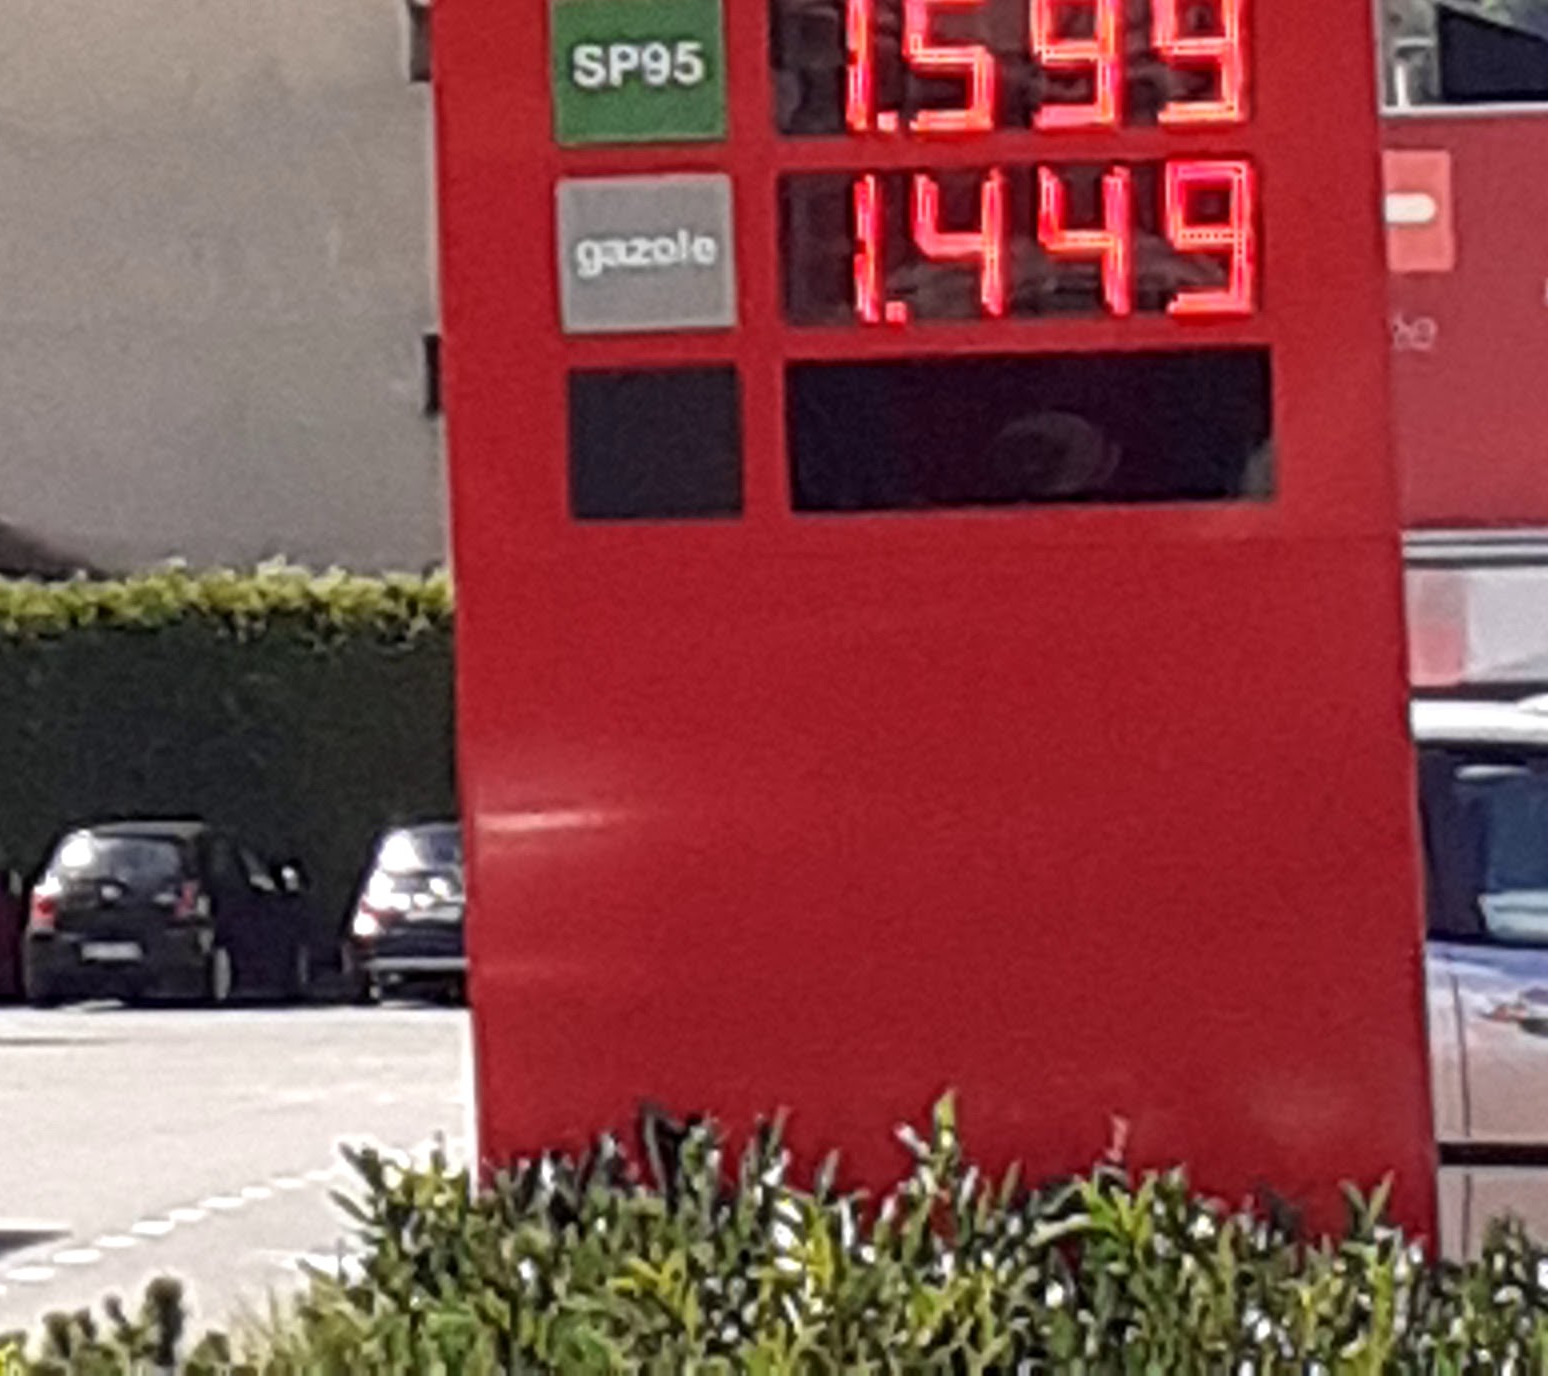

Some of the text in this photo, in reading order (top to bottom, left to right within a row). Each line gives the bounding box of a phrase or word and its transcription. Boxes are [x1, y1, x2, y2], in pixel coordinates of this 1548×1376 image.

[572, 41, 705, 88] SP95
[575, 227, 717, 279] gazole
[853, 159, 1258, 326] 1.449
